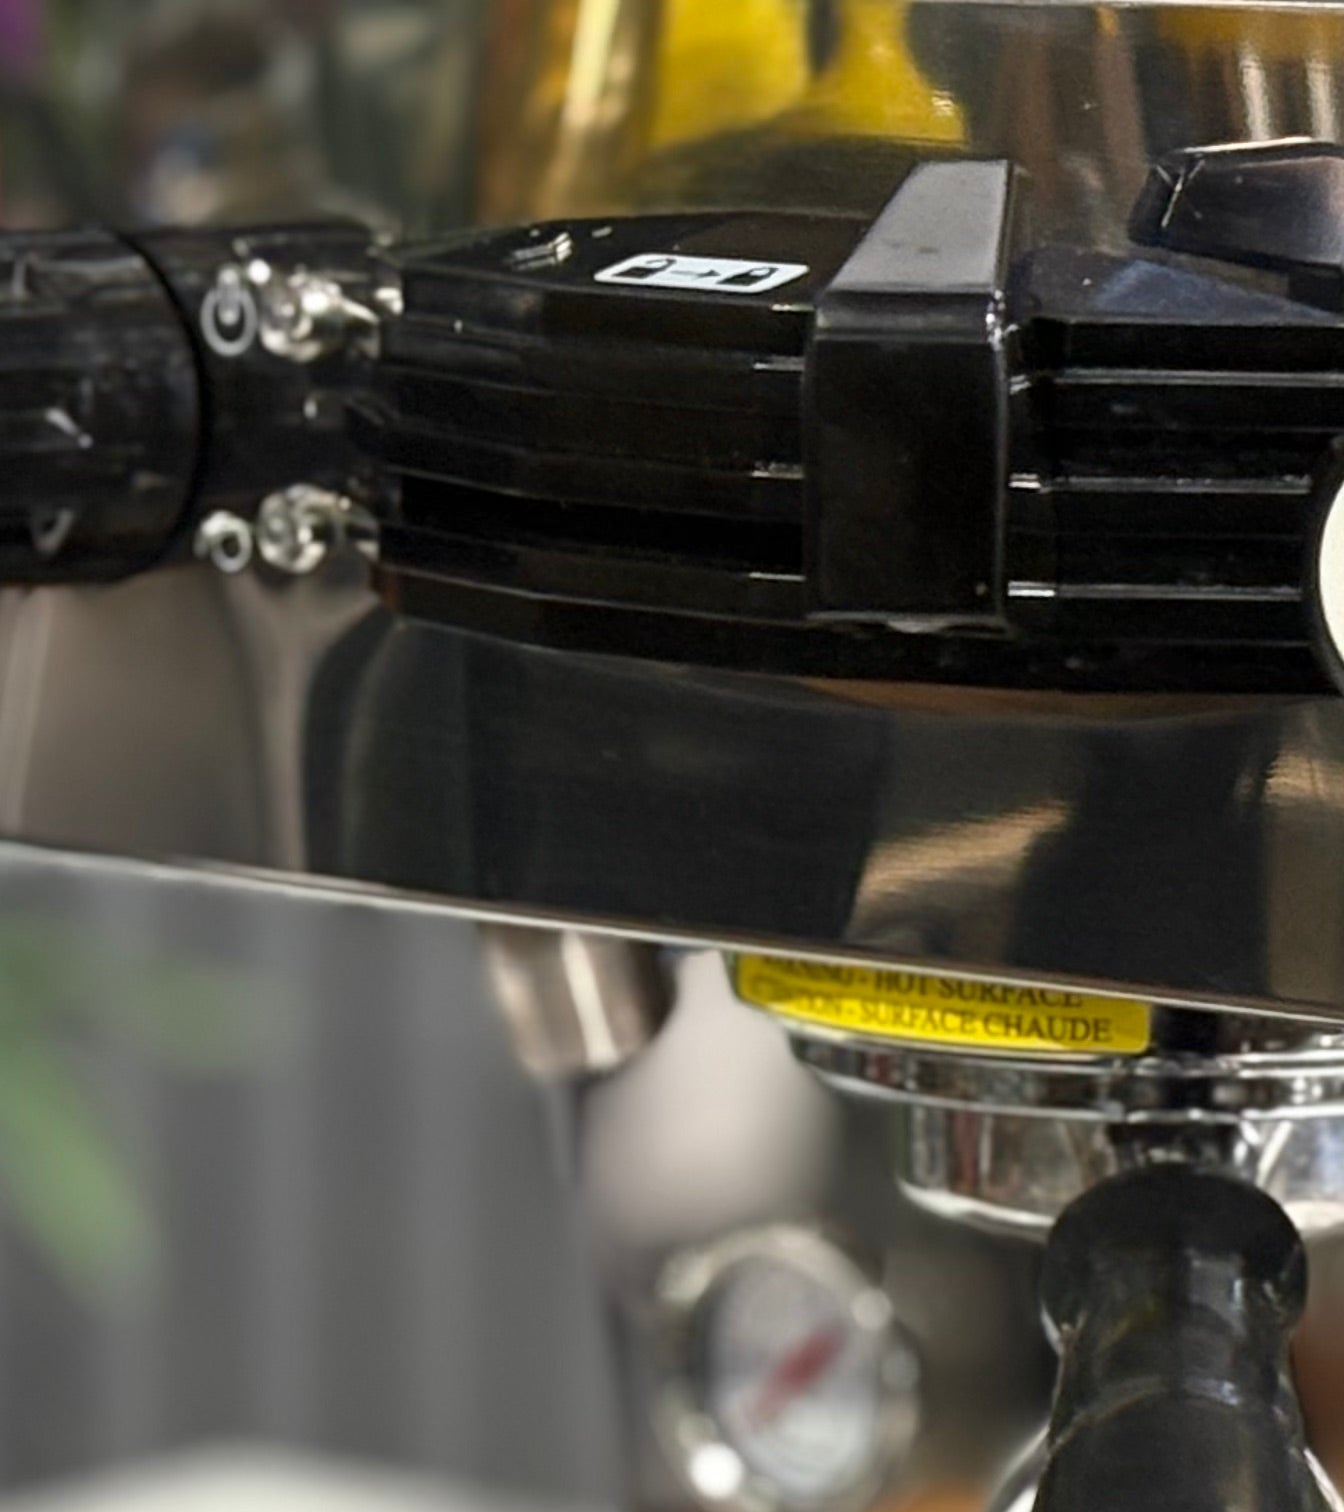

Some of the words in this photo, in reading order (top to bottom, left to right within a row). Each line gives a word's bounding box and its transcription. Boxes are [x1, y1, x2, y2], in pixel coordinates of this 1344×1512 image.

[875, 967, 929, 996] HOT
[939, 976, 1083, 1008] SURFACE
[861, 1000, 977, 1034] SURFACE
[983, 1012, 1113, 1042] CHAUDE
